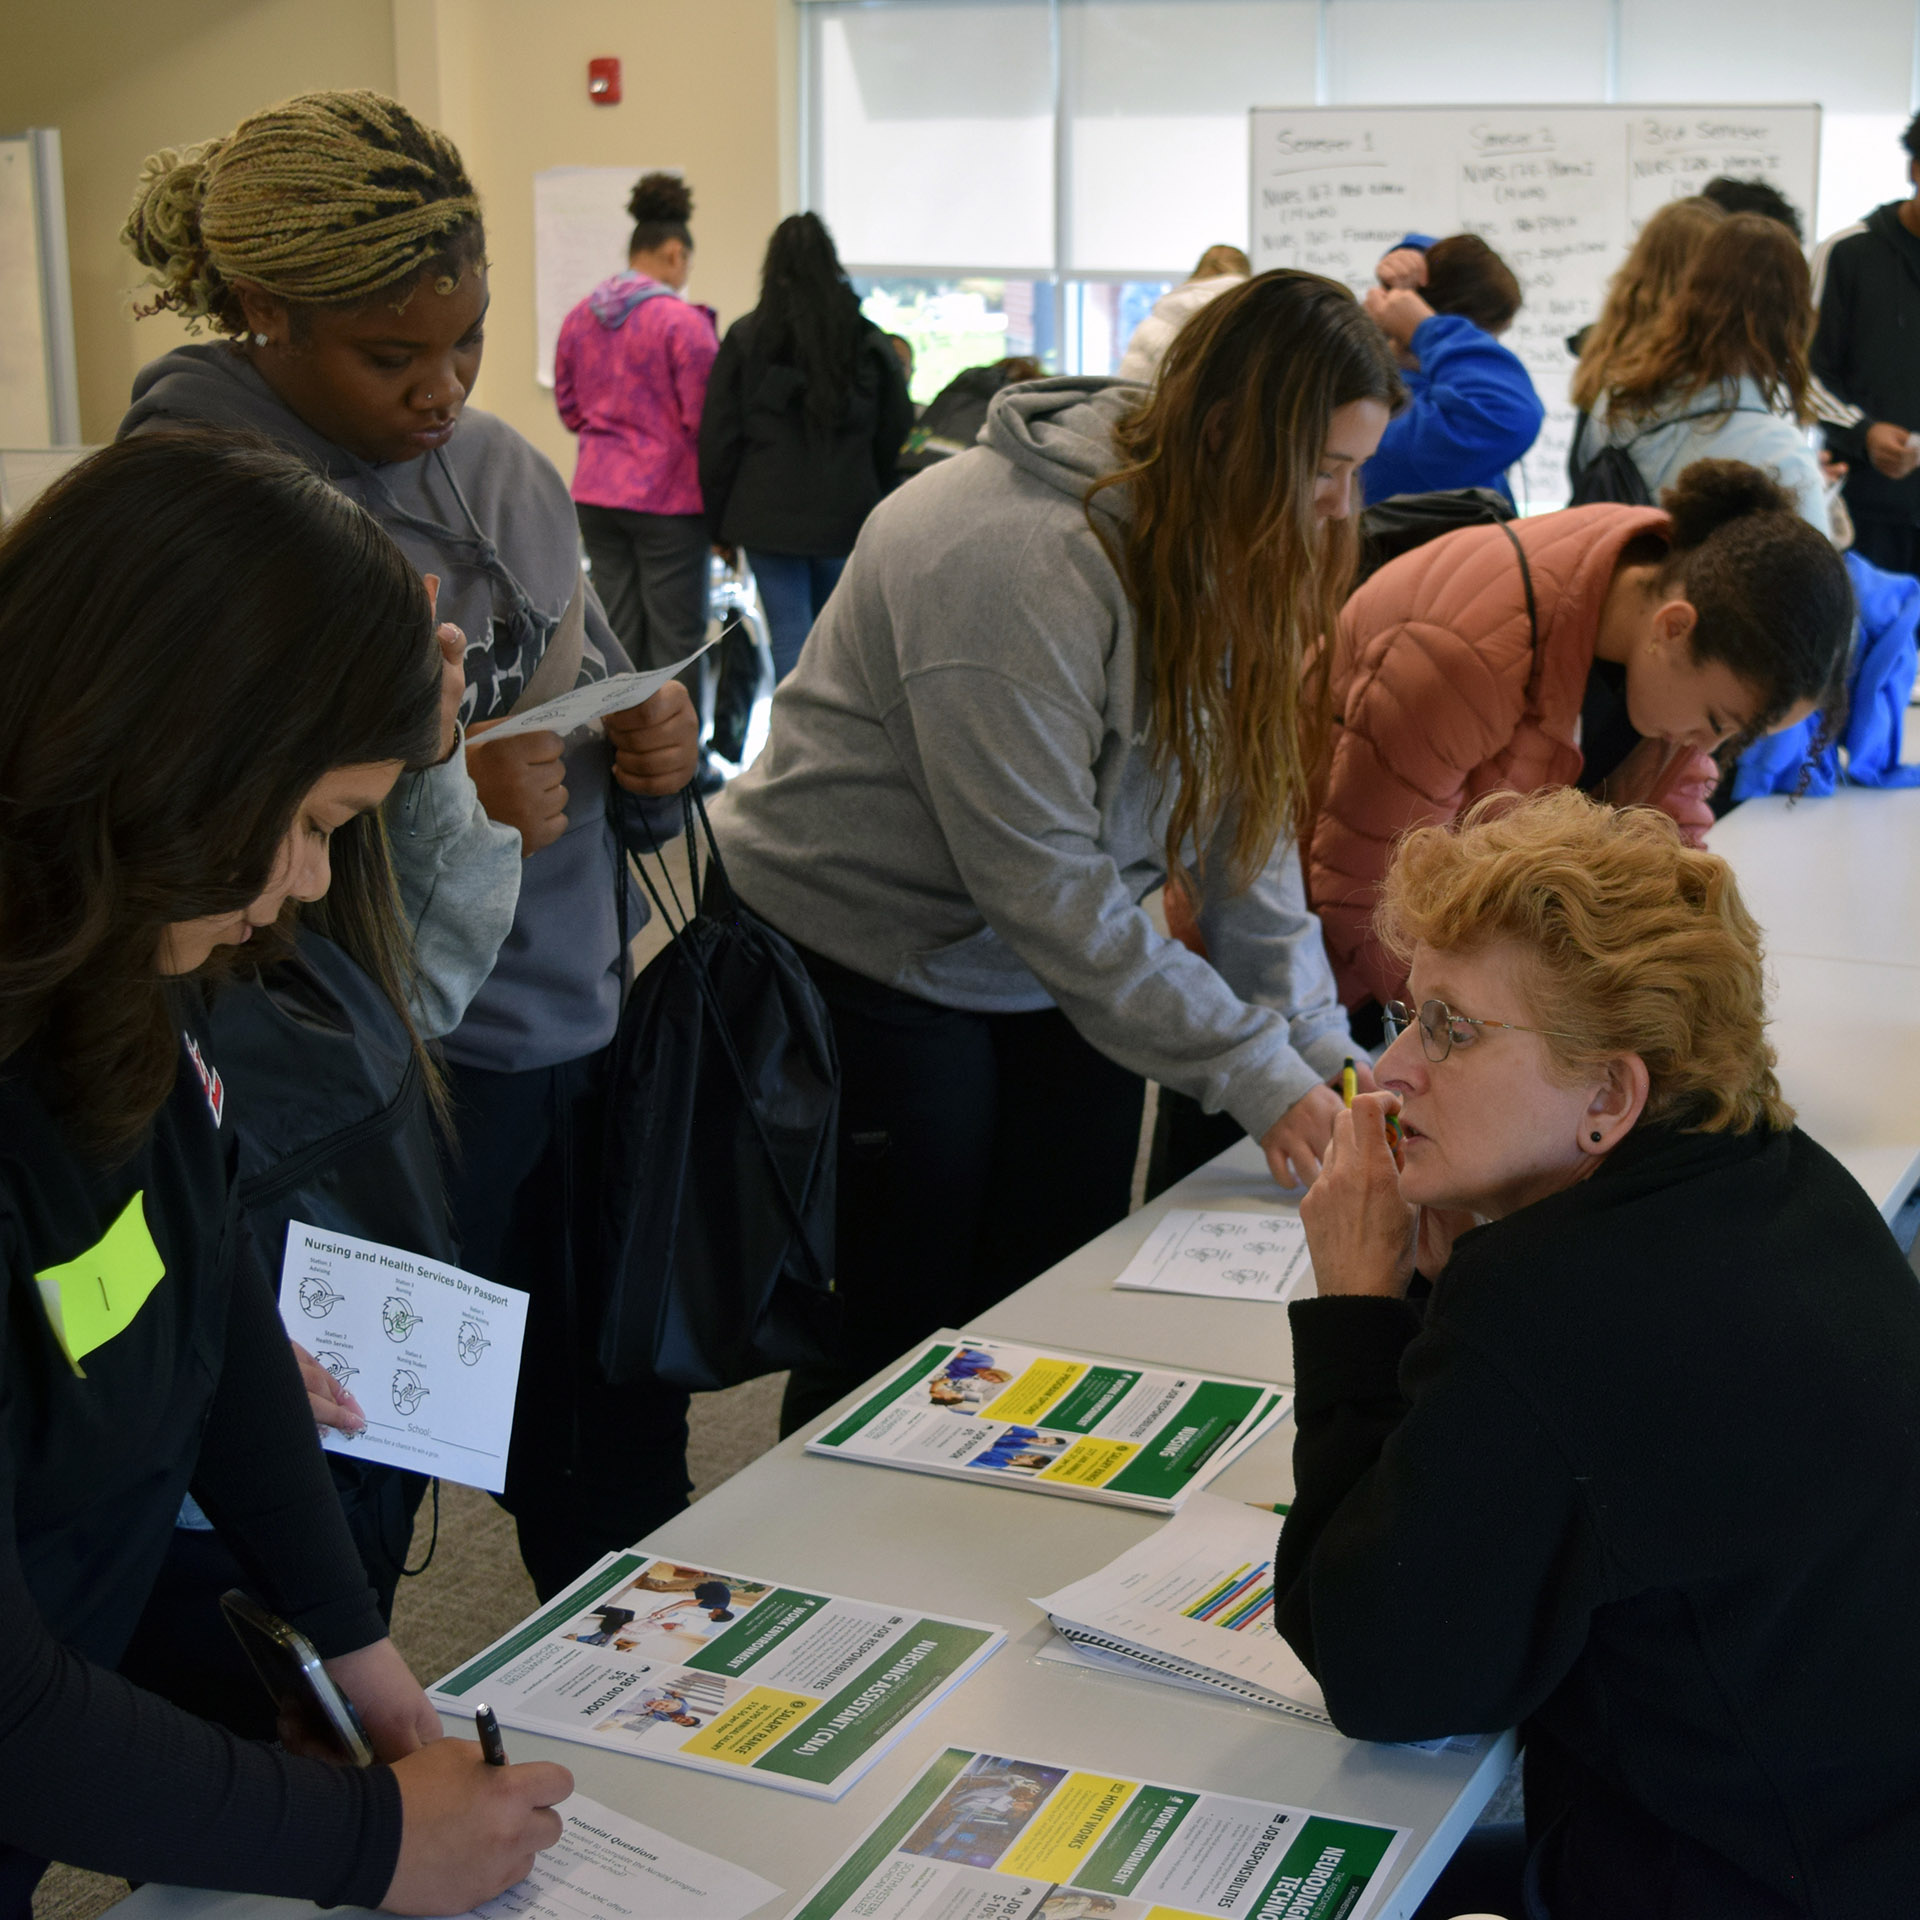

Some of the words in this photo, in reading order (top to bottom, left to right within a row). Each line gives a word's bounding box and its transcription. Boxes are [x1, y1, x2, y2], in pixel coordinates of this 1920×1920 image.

[309, 1257, 328, 1266] Station
[309, 1264, 330, 1276] Advising
[304, 1236, 351, 1259] Nursing
[355, 1250, 376, 1263] and
[379, 1255, 414, 1273] Health
[416, 1265, 454, 1287] Services
[456, 1279, 472, 1295] Day
[474, 1285, 508, 1307] Passport
[395, 1277, 410, 1287] Station
[395, 1286, 411, 1296] Nursing
[315, 1335, 332, 1344] Health
[333, 1339, 353, 1350] Services
[324, 1330, 342, 1339] Station
[1163, 1389, 1180, 1398] JOB
[1128, 1400, 1171, 1436] RESPONSIBILITIES
[407, 1422, 431, 1437] School:
[1157, 1426, 1198, 1456] NURSING
[777, 1607, 807, 1625] WORK
[871, 1625, 893, 1637] JOB
[725, 1626, 785, 1667] ENVIRONMENT
[812, 1638, 879, 1689] RESPONSIBILITIES
[880, 1640, 938, 1681] NURSING
[608, 1671, 627, 1680] 5%
[618, 1674, 641, 1686] JOB
[580, 1687, 624, 1714] OUTLOOK
[826, 1680, 893, 1728] ASSISTANT
[715, 1723, 733, 1733] hour
[726, 1715, 740, 1723] per
[760, 1709, 795, 1733] SALARY
[710, 1734, 734, 1750] SALARY
[734, 1733, 767, 1753] RANGE
[791, 1727, 838, 1756] (CNA)
[1094, 1795, 1117, 1812] HOW
[1087, 1812, 1105, 1821] IT
[1150, 1806, 1178, 1828] WORK
[568, 1816, 611, 1839] Potential
[610, 1836, 658, 1862] Questions
[1066, 1821, 1098, 1848] WORKS
[1261, 1825, 1280, 1839] JOB
[568, 1831, 592, 1844] student
[601, 1847, 632, 1863] complete
[632, 1860, 644, 1869] the
[644, 1866, 671, 1881] Nursing
[1110, 1829, 1162, 1884] ENVIRONMENT
[540, 1870, 575, 1890] programs
[575, 1886, 590, 1895] that
[873, 1861, 903, 1887] MICHIGAN
[1217, 1842, 1271, 1907] RESPONSIBILITIES
[1332, 1872, 1344, 1881] THE
[530, 1882, 545, 1892] the
[860, 1863, 914, 1916] SOUTHWESTERN
[1314, 1882, 1338, 1910] ASSOCIATE
[527, 1900, 546, 1911] start
[544, 1907, 559, 1918] the
[850, 1889, 879, 1913] COLLEGE
[1001, 1898, 1024, 1914] JOB
